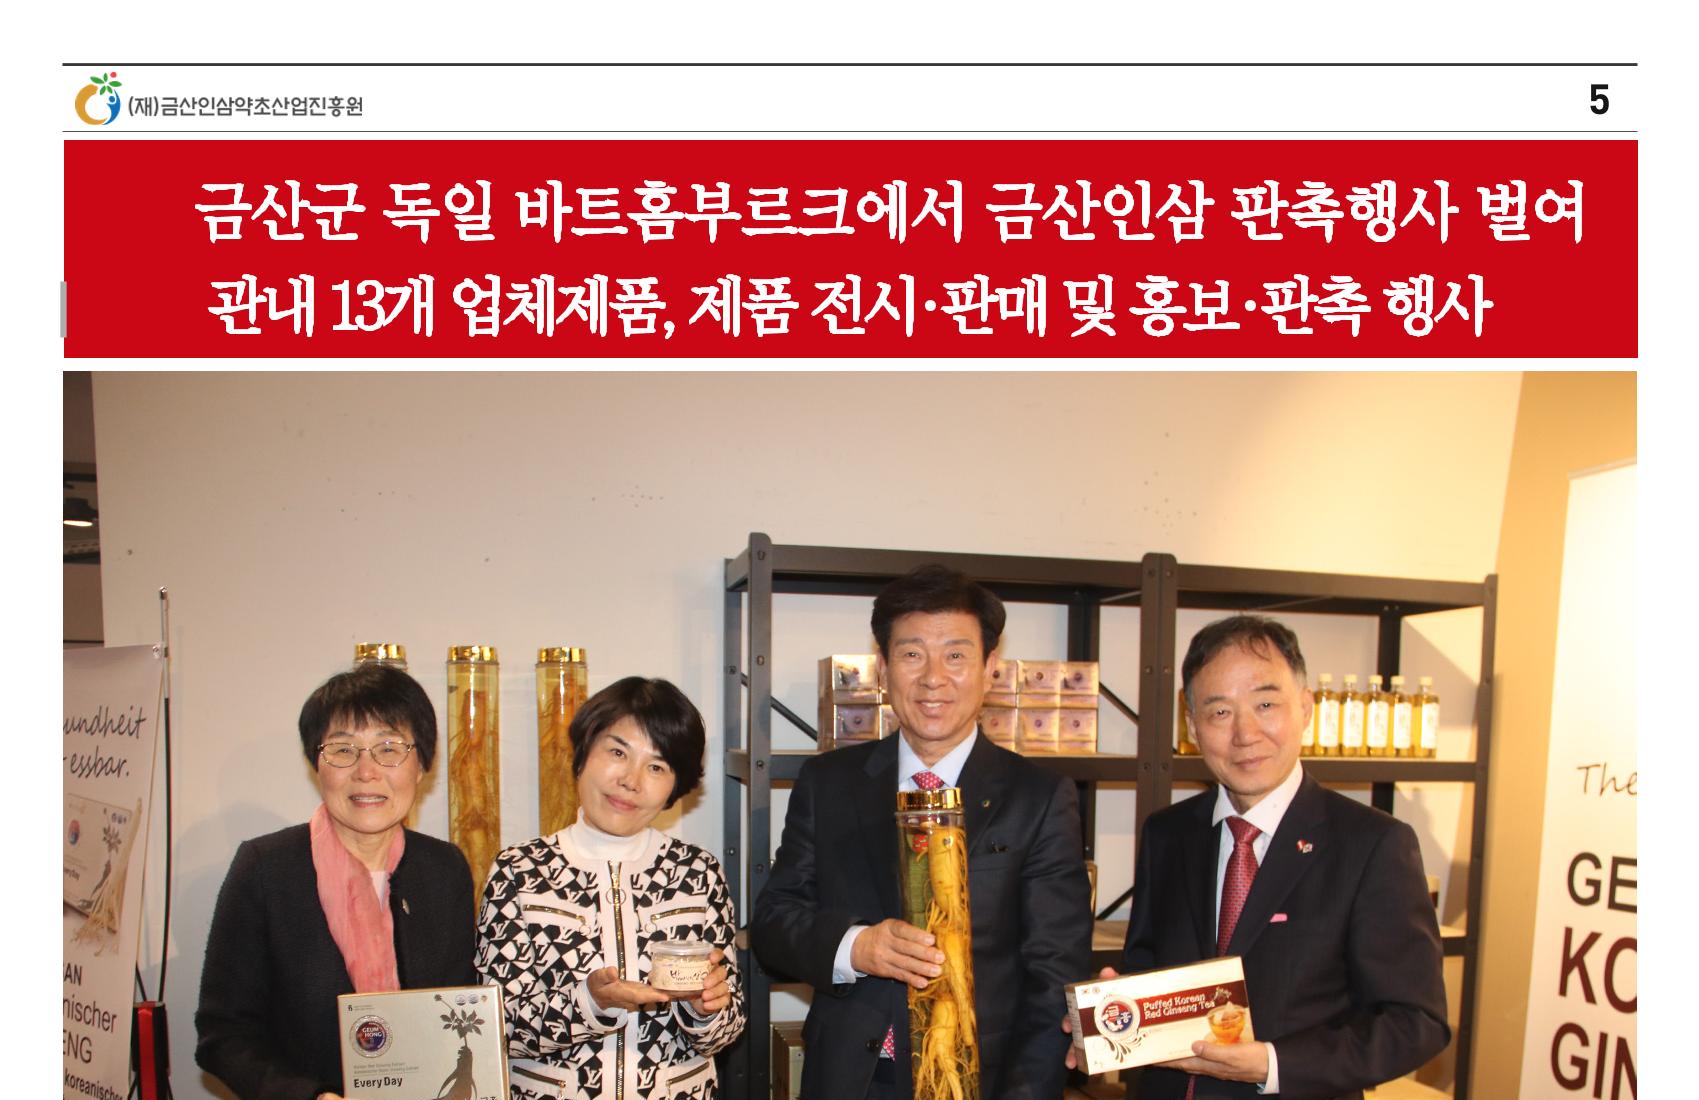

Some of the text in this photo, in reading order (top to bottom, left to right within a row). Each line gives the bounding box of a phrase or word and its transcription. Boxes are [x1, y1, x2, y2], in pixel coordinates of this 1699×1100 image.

[129, 96, 362, 117] (재)금산인삼약초산업진흥원
[1590, 84, 1609, 115] 5
[195, 180, 1583, 244] 금산군 독일 바트홈부르크에서 금산인삼 판촉행사 벌여
[208, 274, 1494, 339] 관내 13개 업체제품, 제품 전시·판매 및 홍보·판촉 행사
[70, 745, 129, 778] essbar.
[1143, 994, 1205, 1011] Puffed Korean
[1144, 1001, 1215, 1020] Red Ginseng Tea
[353, 1076, 403, 1089] Every Day
